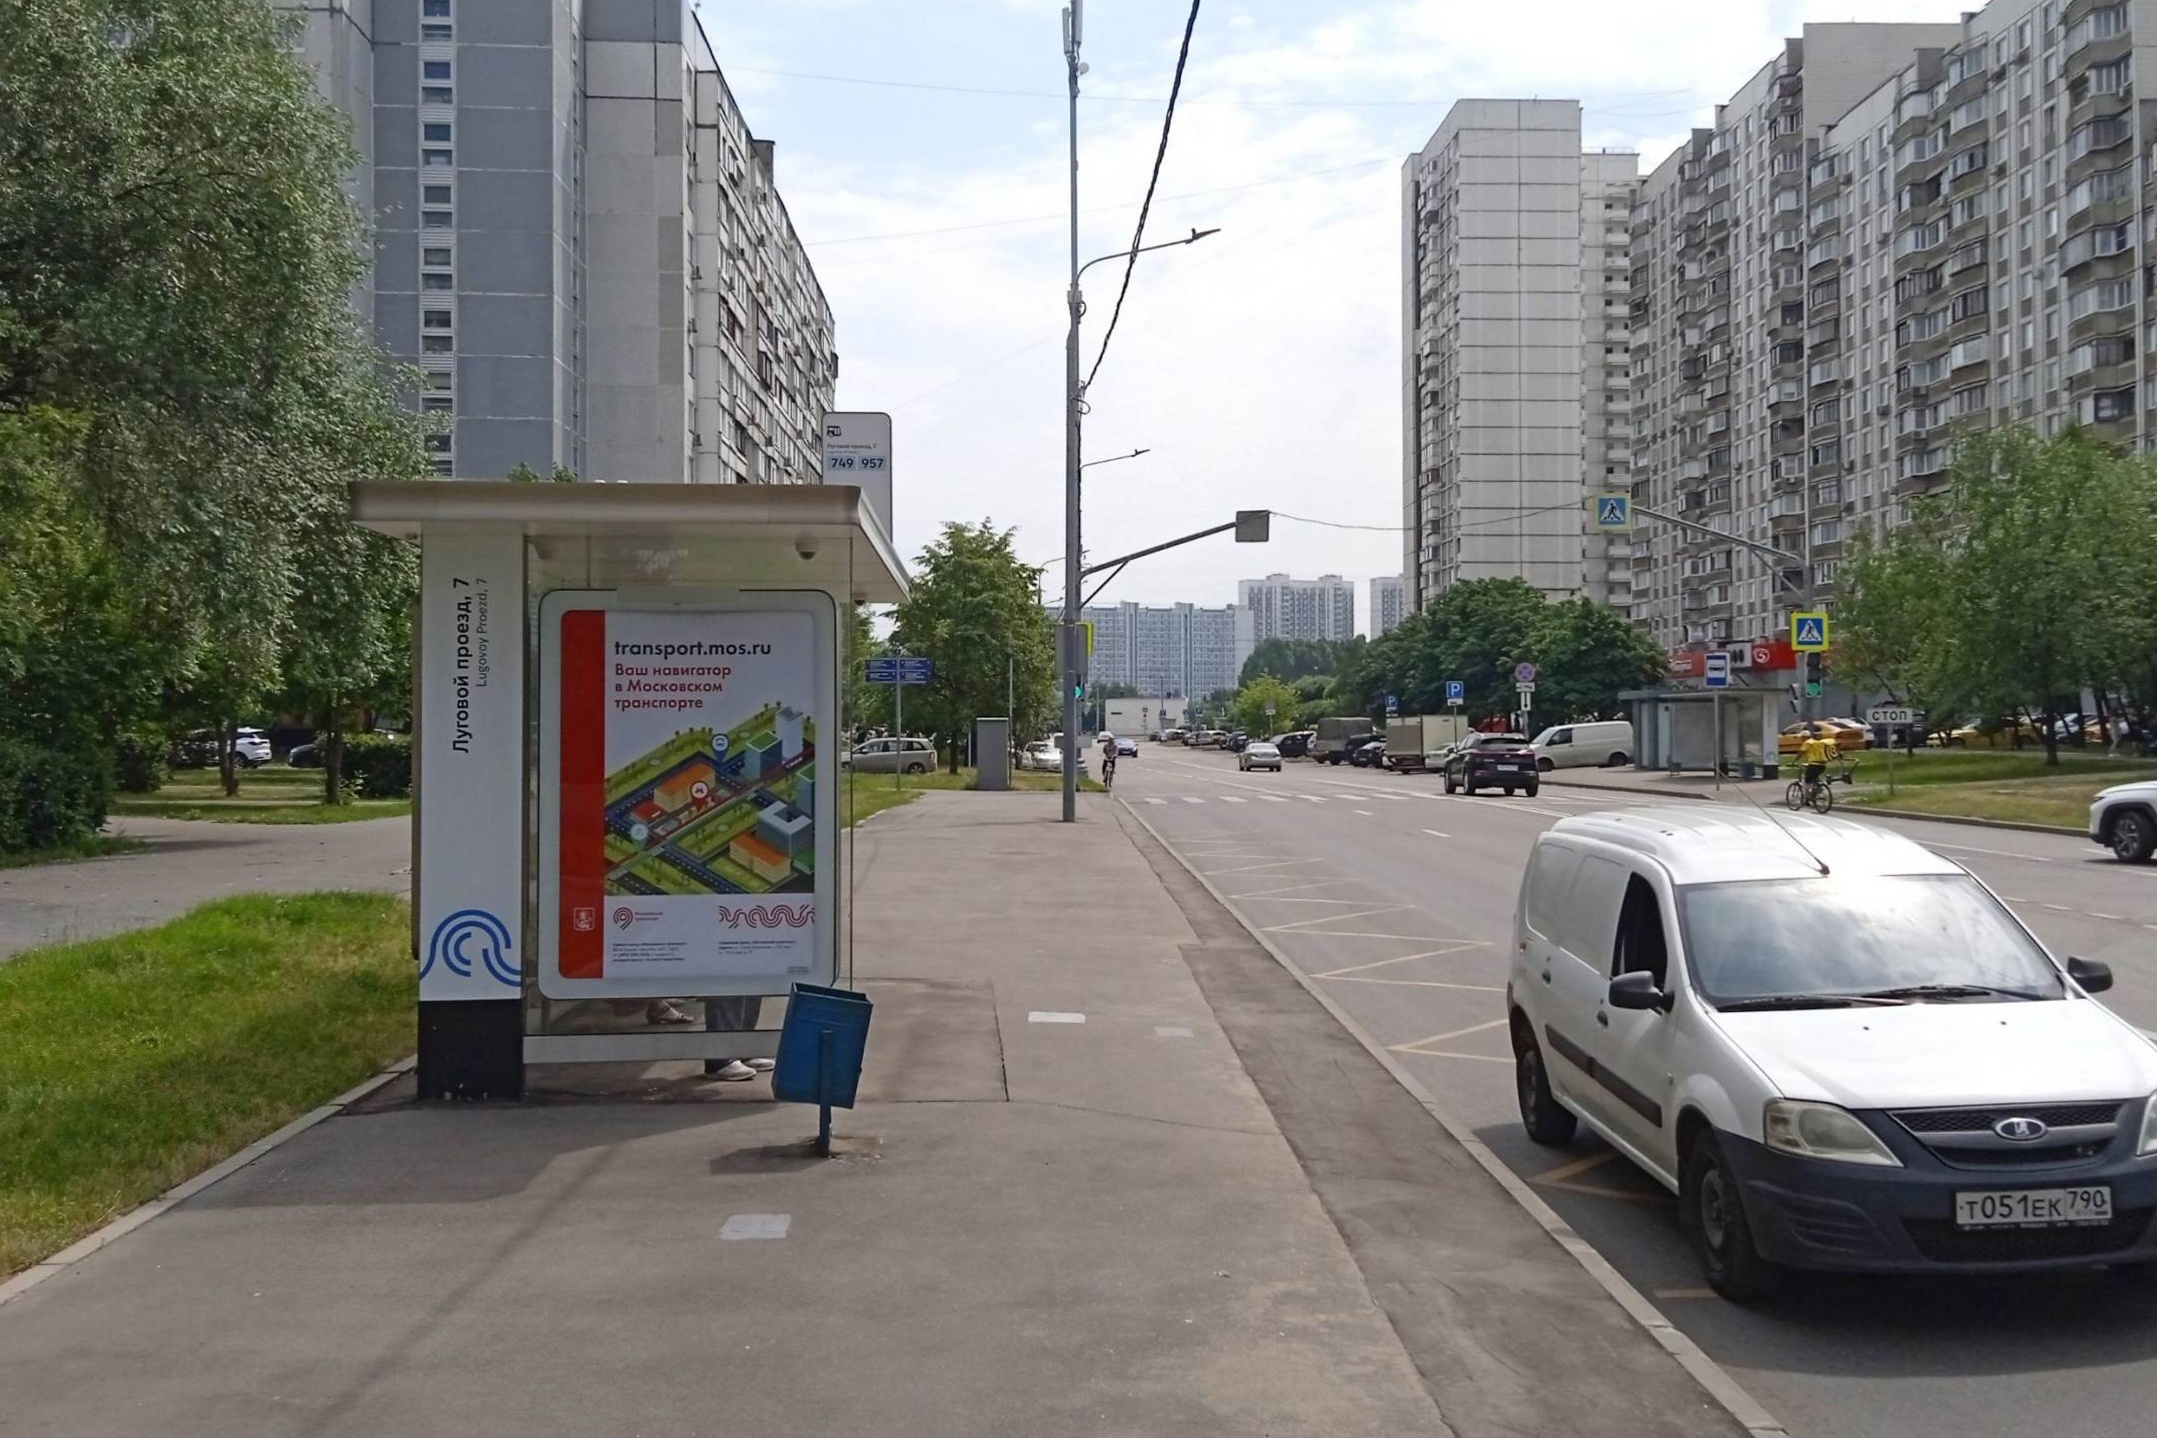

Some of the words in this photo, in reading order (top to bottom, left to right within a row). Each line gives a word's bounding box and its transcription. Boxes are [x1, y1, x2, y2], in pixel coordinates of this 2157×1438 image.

[831, 458, 854, 468] 749
[862, 458, 884, 469] 957
[453, 578, 469, 589] 7
[476, 589, 489, 634] Proezd,
[456, 596, 473, 669] проезд,
[614, 641, 772, 660] transport.mos.ru
[476, 638, 489, 687] Lugovoy
[615, 663, 648, 676] Ваш
[653, 666, 731, 679] навигатор
[615, 683, 622, 692] в
[627, 680, 723, 692] Московском
[1451, 683, 1460, 696] P
[614, 699, 703, 712] транспорте
[453, 676, 473, 753] Луговой
[1872, 710, 1907, 721] СТОП
